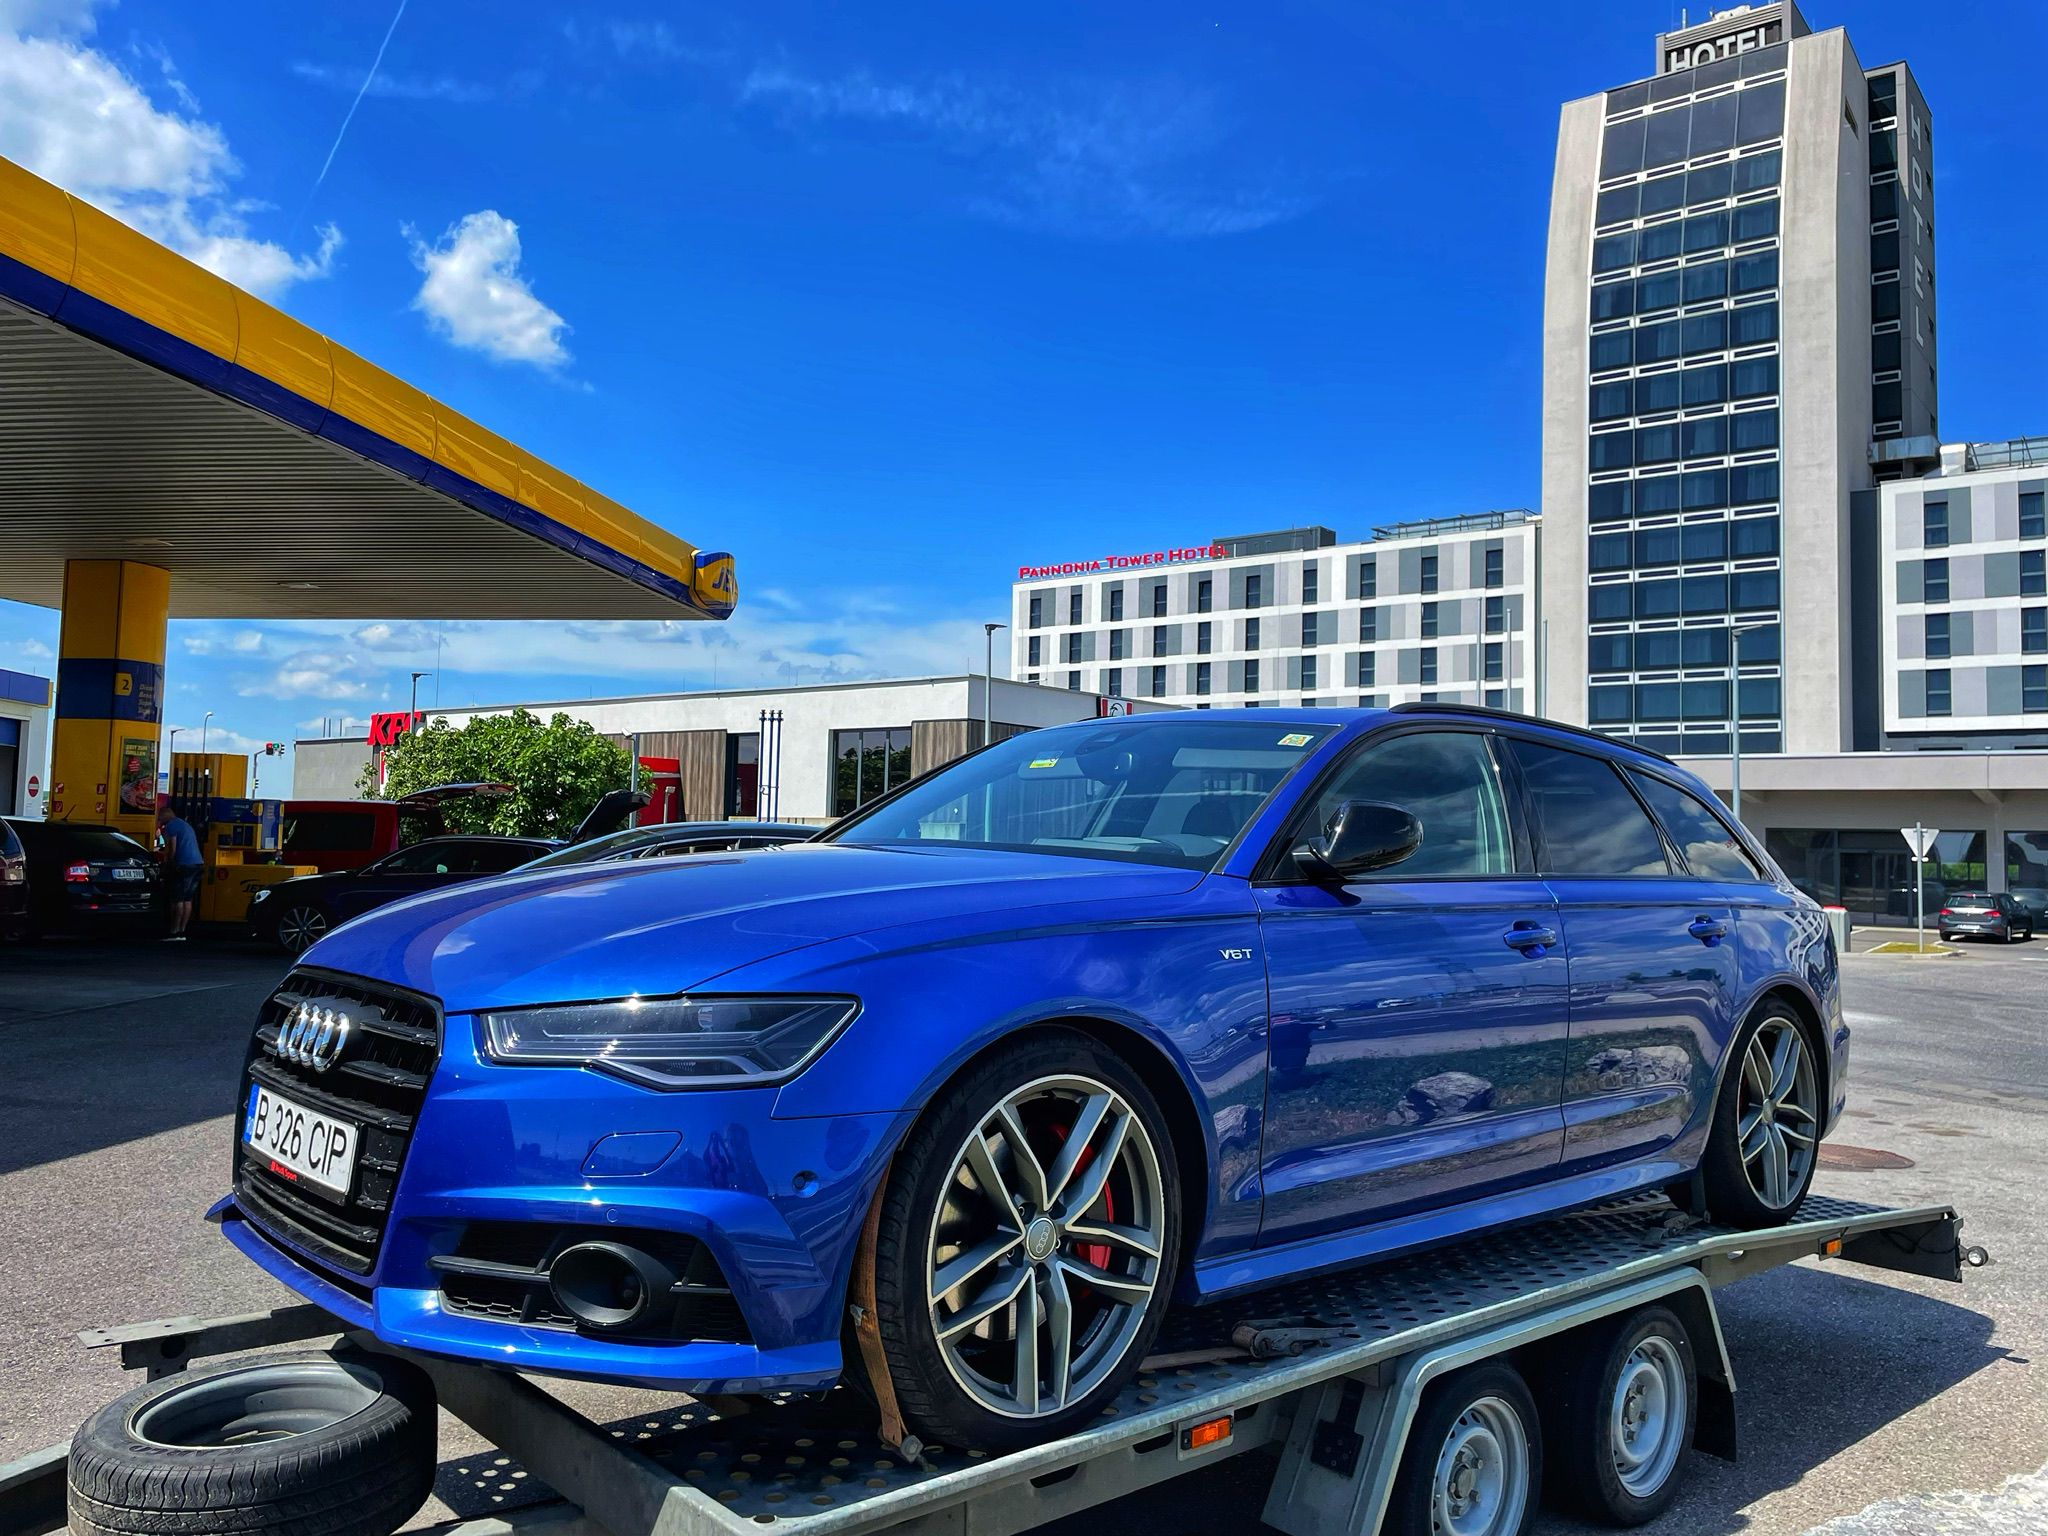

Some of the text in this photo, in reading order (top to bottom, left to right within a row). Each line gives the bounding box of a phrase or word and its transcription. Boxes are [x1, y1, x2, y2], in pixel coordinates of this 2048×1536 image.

[1911, 103, 1926, 348] HOTEL
[1019, 544, 1229, 579] PANNONIA TOWER HOTEL
[122, 679, 129, 690] 2
[1219, 948, 1252, 960] V6T
[255, 1094, 347, 1176] B 326 CIP
